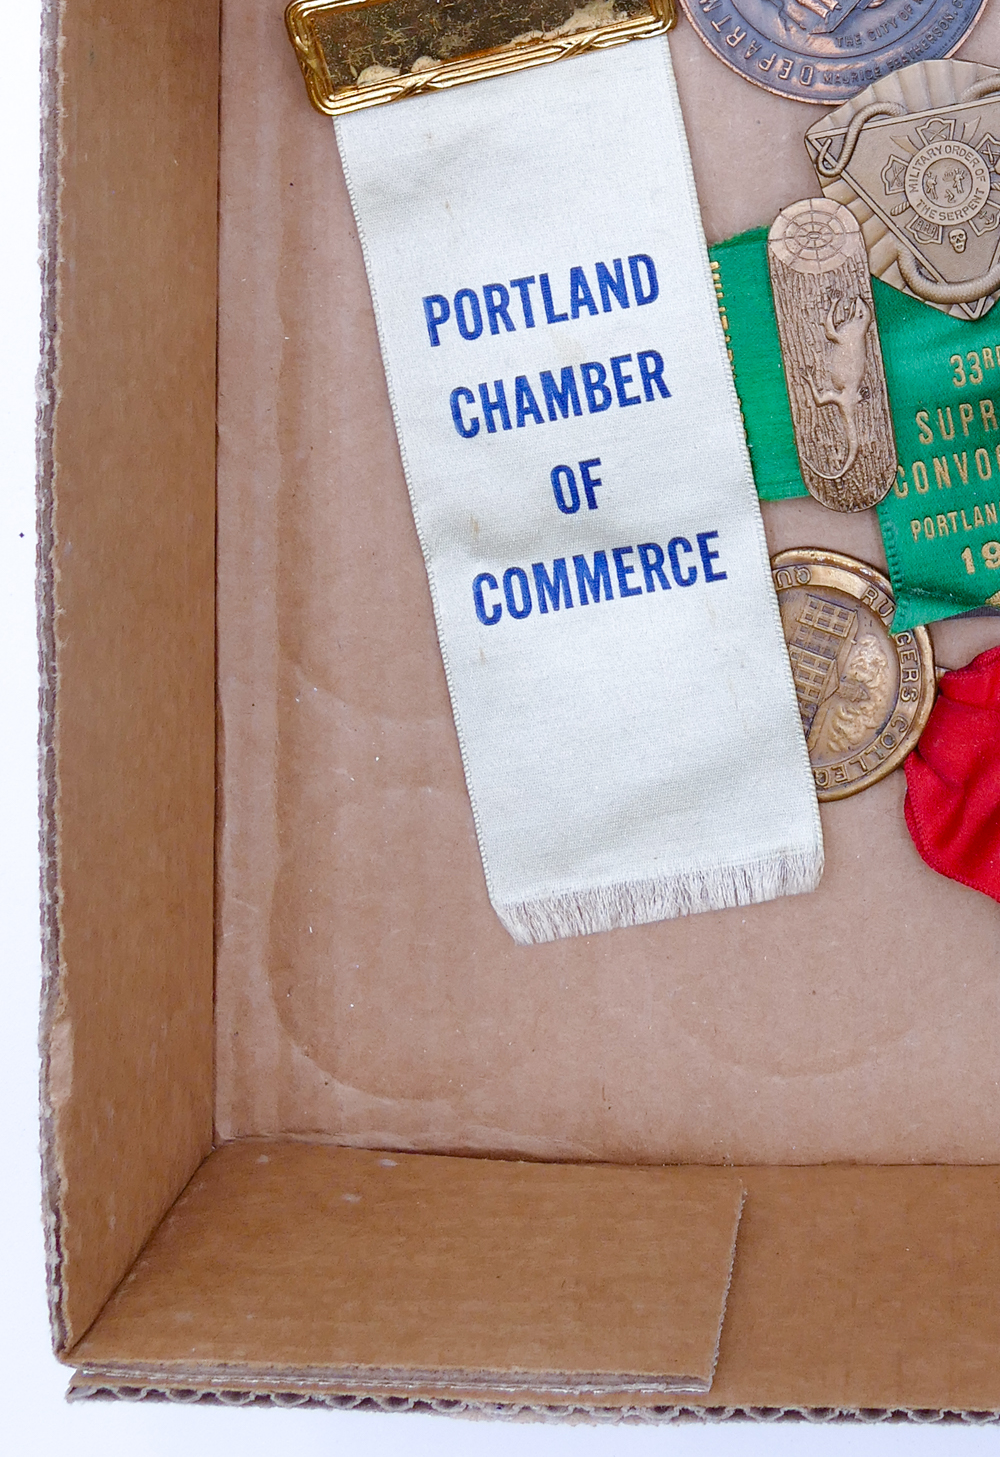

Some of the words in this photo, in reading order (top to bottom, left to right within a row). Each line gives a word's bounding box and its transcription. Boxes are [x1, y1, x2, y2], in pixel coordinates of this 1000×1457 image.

[836, 34, 863, 48] THE
[868, 17, 898, 41] CITY
[899, 3, 914, 21] OF
[823, 65, 883, 87] MAURICE
[907, 145, 943, 193] MILITARY
[944, 144, 980, 172] ORDER
[973, 166, 987, 183] OF
[916, 199, 938, 220] THE
[937, 189, 986, 221] SERPENT
[422, 251, 662, 348] PORTLAND
[447, 348, 672, 440] CHAMBER
[548, 456, 604, 518] OF
[470, 529, 730, 627] COMMERCE
[860, 585, 919, 703] RUGERS
[812, 715, 909, 787] COLLEG
